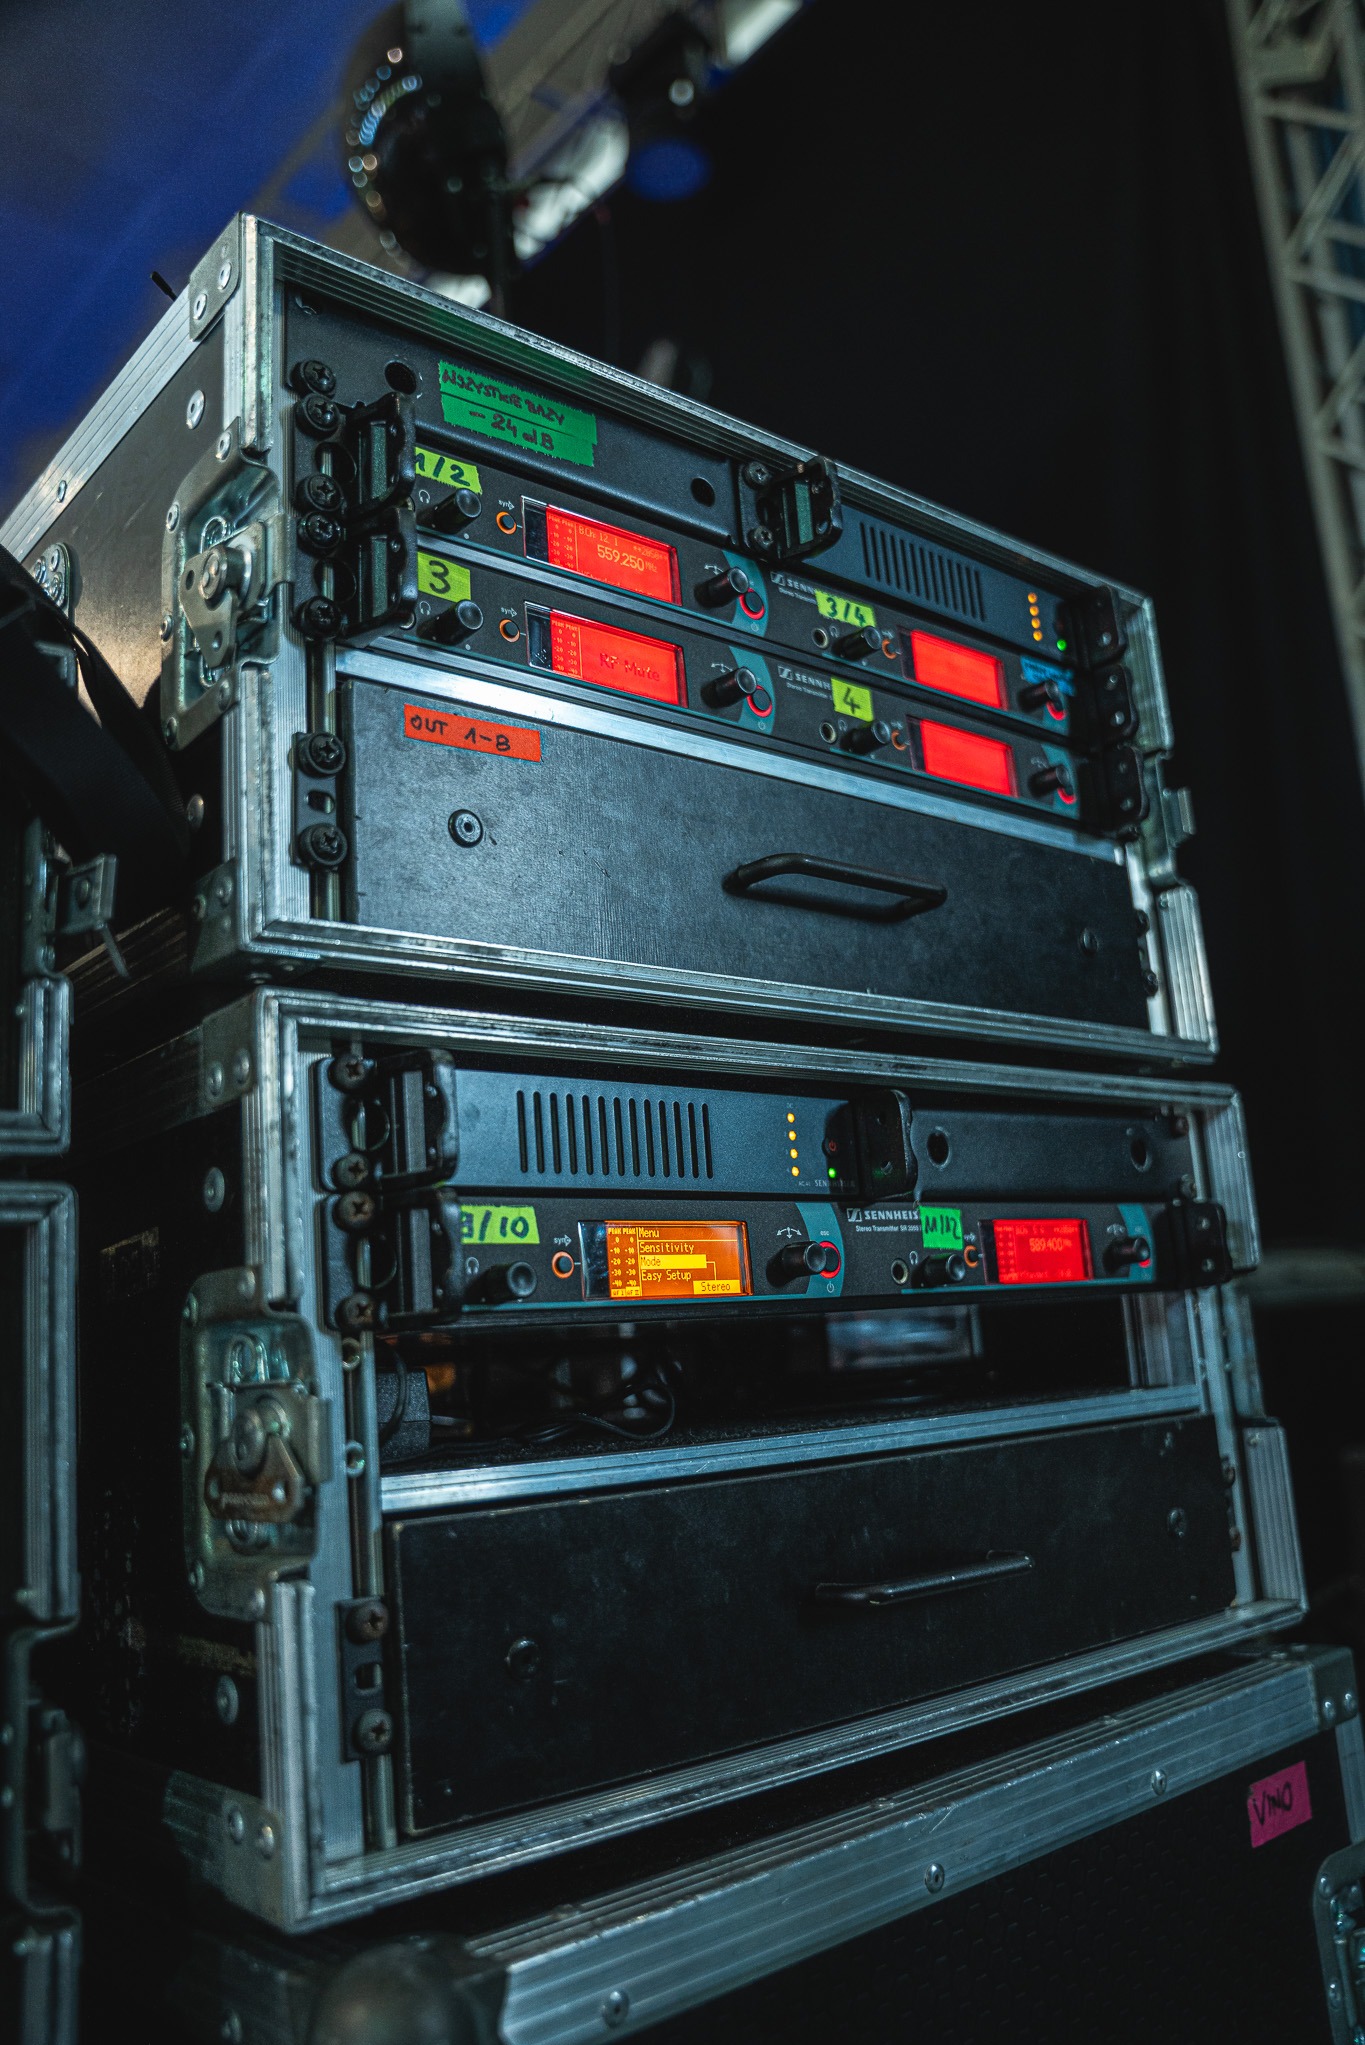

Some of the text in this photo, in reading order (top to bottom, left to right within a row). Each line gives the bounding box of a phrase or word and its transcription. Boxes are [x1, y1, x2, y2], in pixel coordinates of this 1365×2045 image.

[597, 543, 645, 571] 559.250
[429, 560, 450, 594] 3
[826, 597, 866, 627] 3/4
[600, 652, 661, 682] RF Mute
[795, 673, 832, 691] SENNH
[843, 687, 860, 715] 4
[411, 714, 448, 735] OUT
[864, 1210, 919, 1220] SENNHEIS
[638, 1227, 660, 1239] Menu
[639, 1242, 695, 1254] Sensitivity
[640, 1256, 662, 1267] Mode
[641, 1269, 692, 1282] Easy Setup
[700, 1281, 731, 1292] Stereo
